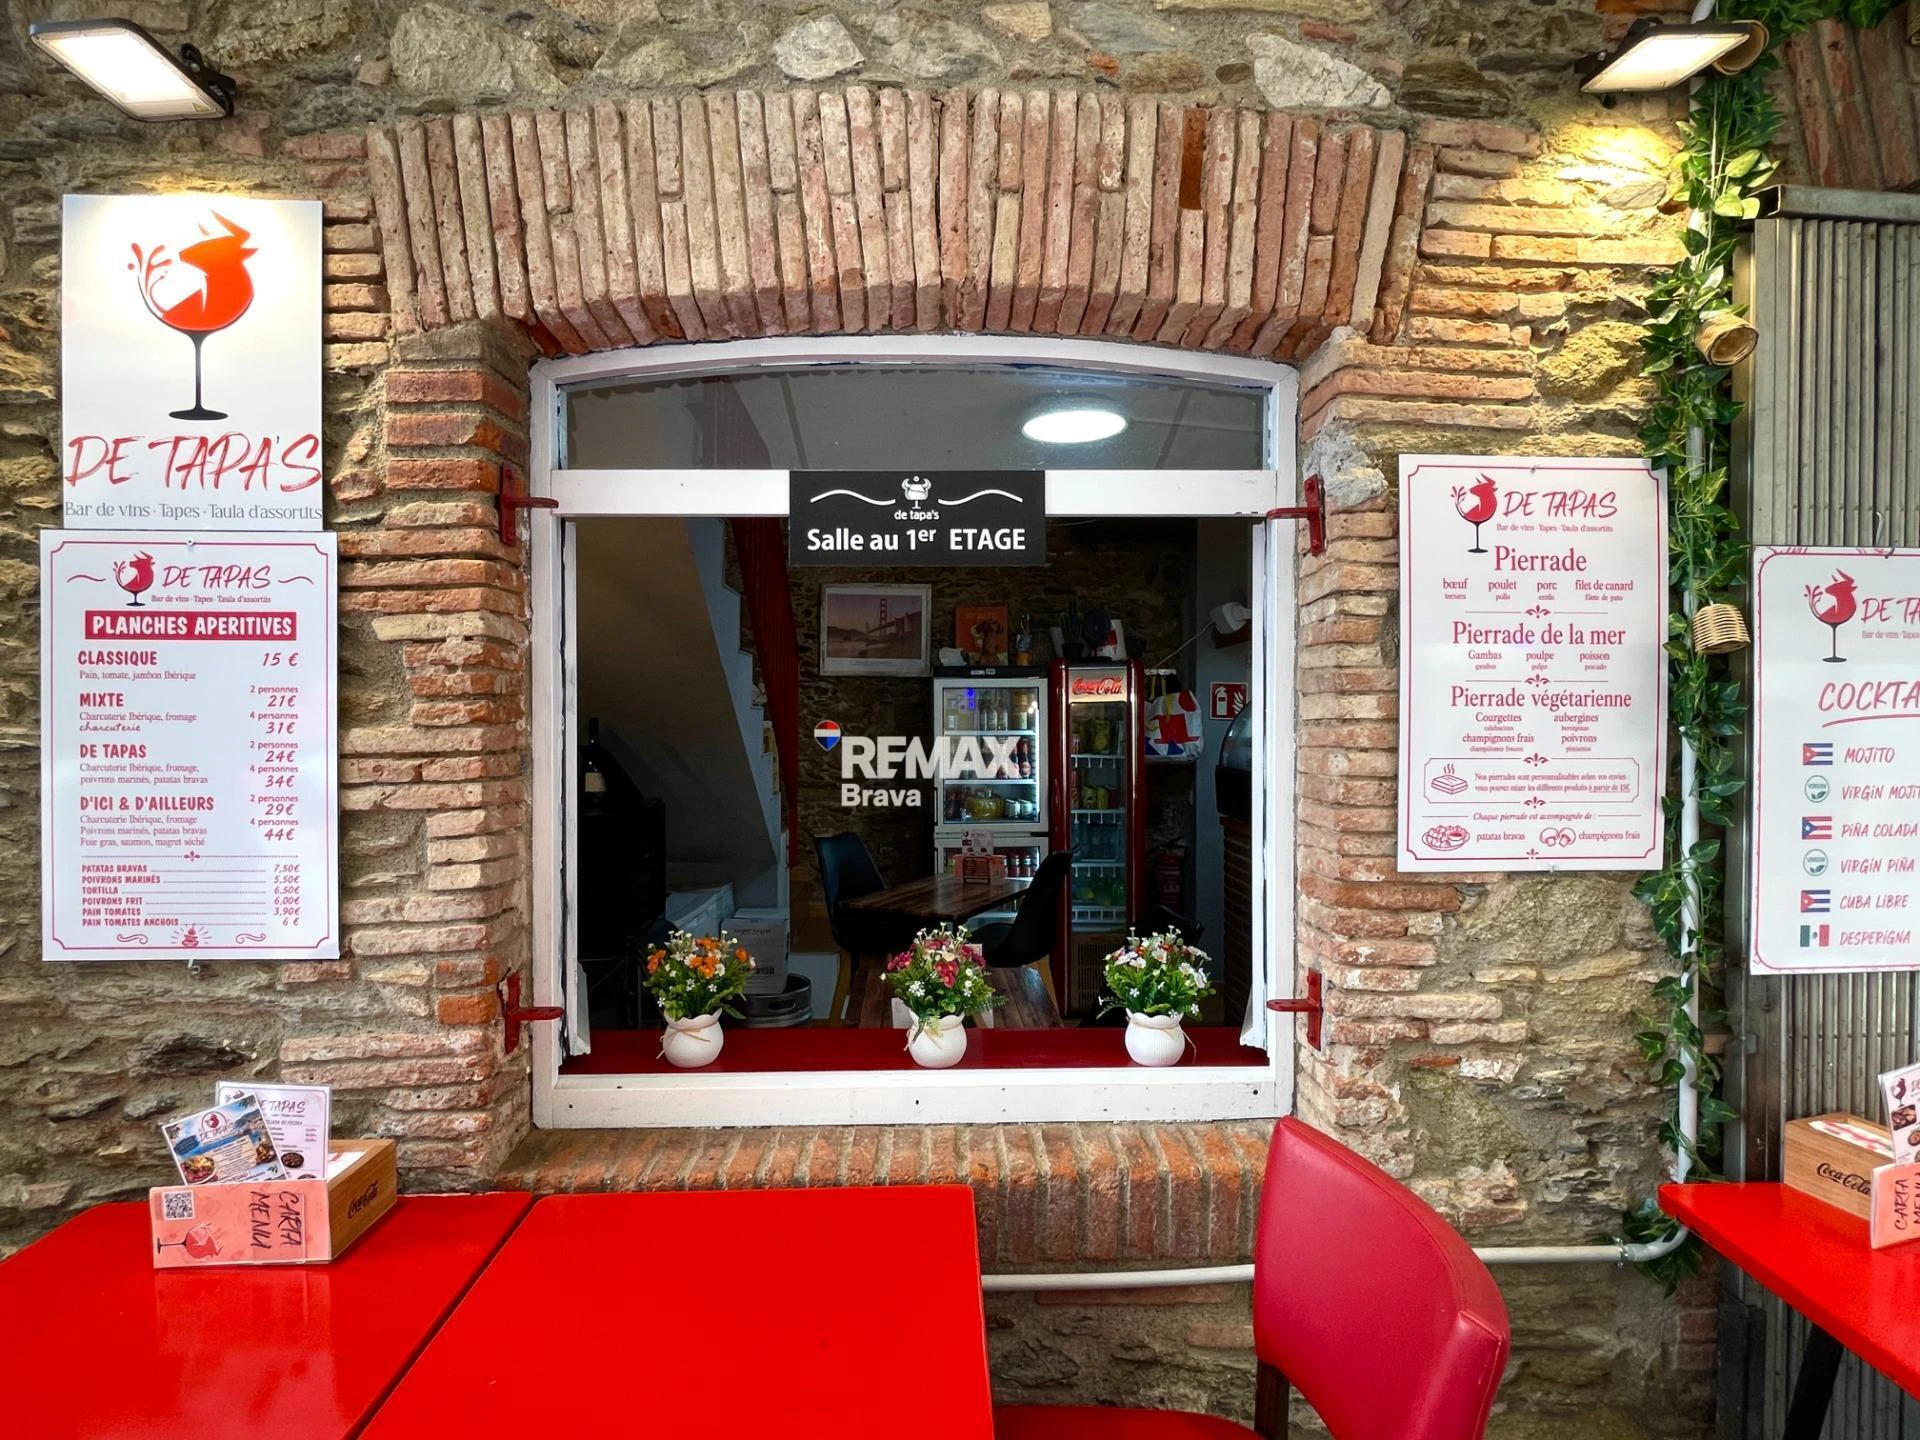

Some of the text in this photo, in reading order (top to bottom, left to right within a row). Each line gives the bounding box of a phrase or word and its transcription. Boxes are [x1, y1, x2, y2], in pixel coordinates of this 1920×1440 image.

[64, 432, 322, 492] DE TAPA'S
[1503, 489, 1618, 518] DE TAPAS
[65, 502, 322, 521] Bar de vins Tapes Taula d'assortits
[894, 510, 940, 521] de tapa's
[807, 528, 1026, 550] Salle au 1er ETAGE
[1494, 545, 1587, 571] Pierrade
[162, 565, 271, 589] DE TAPAS
[1488, 579, 1517, 592] poulet
[1537, 581, 1557, 593] porc
[1575, 580, 1592, 591] filet
[1593, 580, 1604, 591] de
[1605, 580, 1634, 591] canard
[1861, 597, 1896, 624] DE
[93, 616, 292, 635] PLANCHES APERITIVES
[1452, 621, 1626, 645] Pierrade de la mer
[78, 651, 158, 666] CLASSIQUE
[263, 653, 299, 666] 15 €
[1468, 650, 1610, 662] Gambas poulpe poisson
[80, 671, 196, 681] Pain, tomate, jambon Ibérique
[250, 685, 299, 695] 2 personnes
[80, 693, 124, 707] MIXTE
[267, 695, 296, 707] 21€
[1451, 685, 1632, 711] Pierrade végétarienne
[79, 712, 197, 723] Charcuterie Ibérique, fromage
[250, 711, 299, 721] 4 personnes
[1475, 712, 1599, 724] Courgettes aubergines
[265, 722, 295, 734] 31€
[1462, 732, 1597, 745] champignons frais poivrons
[80, 744, 147, 758] DE TAPAS
[250, 741, 299, 751] 2 personnes
[265, 750, 295, 762] 24€
[80, 763, 199, 773] Charcuterie Ibérique, fromage,
[258, 766, 299, 775] personnes
[80, 776, 115, 785] poivrons
[154, 776, 181, 785] patatas
[183, 776, 208, 784] bravas
[265, 775, 295, 788] 34€
[80, 797, 214, 811] D'ICI & D'AILLEURS
[250, 794, 299, 804] 2 personnes
[265, 803, 295, 816] 29€
[80, 815, 127, 824] Charcuterie
[166, 815, 197, 825] fromage
[250, 818, 299, 827] 4 personnes
[1473, 812, 1499, 822] Chaque
[1500, 812, 1528, 822] pierrade
[1585, 812, 1593, 820] de
[153, 827, 180, 836] patatas
[182, 827, 207, 835] bravas
[264, 828, 295, 841] 44€
[1476, 831, 1641, 842] patatas bravas champignons frais
[1873, 823, 1918, 838] COLADA
[80, 838, 97, 846] Foie
[100, 838, 119, 848] gras,
[155, 838, 181, 847] magret
[82, 864, 299, 873] PATATAS BRAVAS 7,50€
[82, 874, 299, 884] POIVRONS MARINÉS 5,50€
[82, 886, 118, 895] TORTILLA
[82, 896, 299, 905] POIVRONS FRIT 6,00€
[1840, 895, 1871, 910] CUBA
[82, 907, 299, 916] PAIN TOMATES 3,90€
[82, 918, 299, 927] PAIN TOMATES ANCHOIS 6 €
[1817, 1162, 1872, 1196] Coca-Cola
[1894, 1179, 1909, 1230] CARTA
[248, 1191, 272, 1249] MENU
[278, 1191, 302, 1246] CARTA
